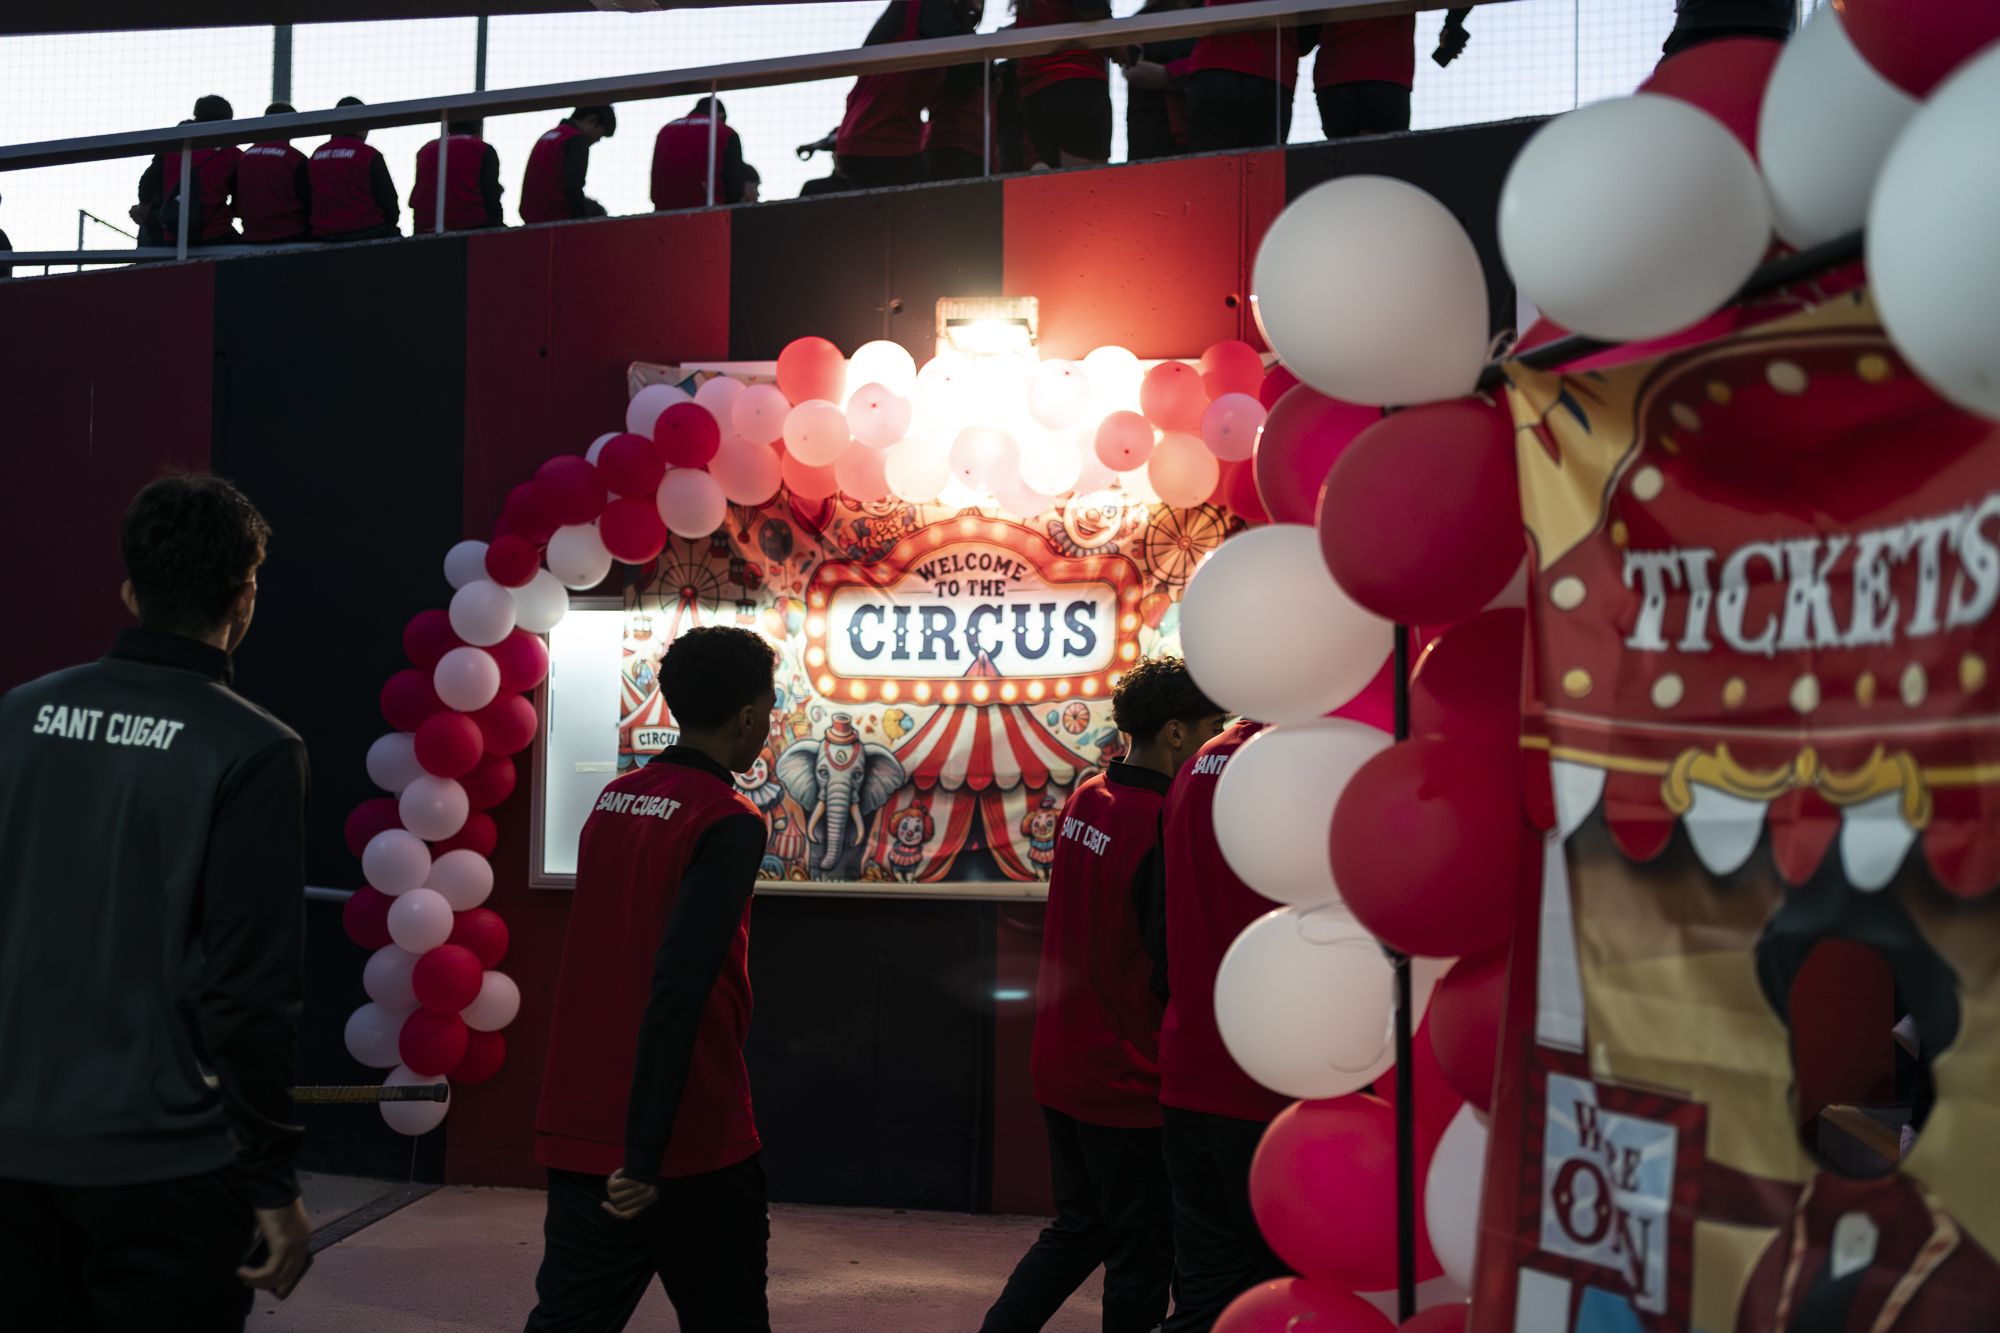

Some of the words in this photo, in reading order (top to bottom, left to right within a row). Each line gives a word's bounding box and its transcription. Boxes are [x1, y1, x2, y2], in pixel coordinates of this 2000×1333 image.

[915, 552, 1027, 583] WELCOME
[1622, 491, 2000, 657] TICKETS
[935, 580, 961, 598] TO
[966, 578, 1006, 597] THE
[846, 600, 1098, 661] CIRCUS
[33, 704, 103, 741] SANT
[105, 713, 185, 750] CUGAT
[638, 731, 677, 746] CIRCU
[595, 791, 637, 814] SANT
[630, 793, 682, 821] CUGAT
